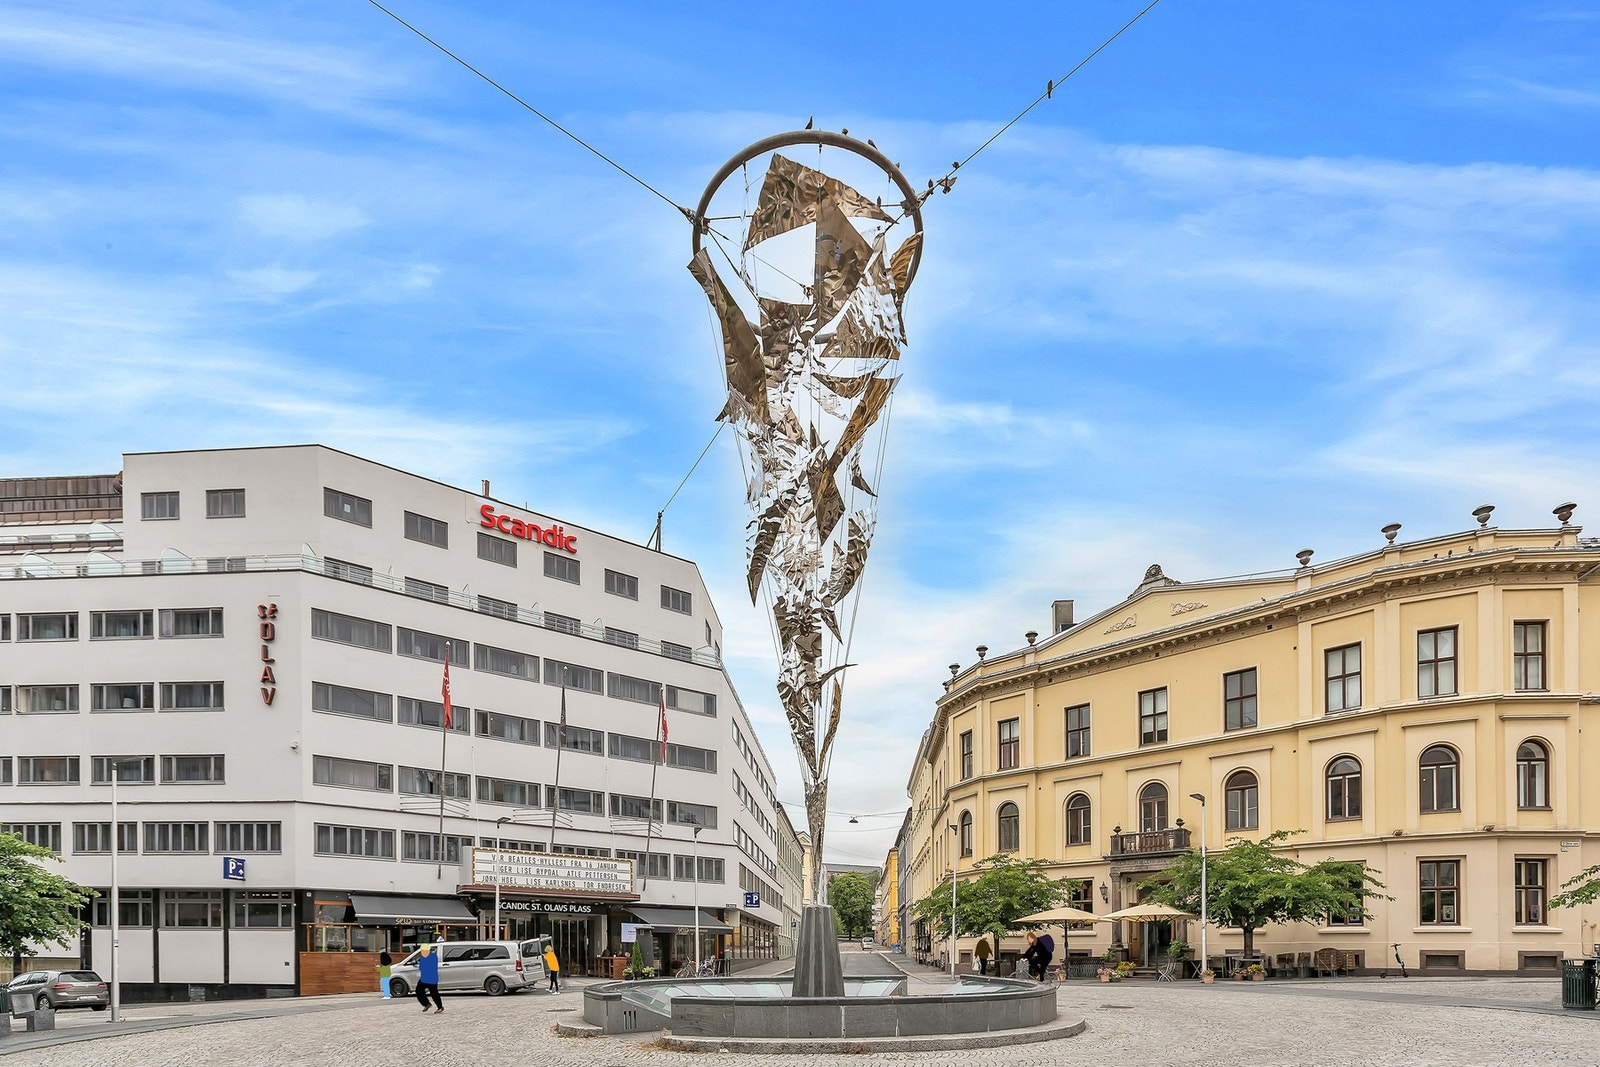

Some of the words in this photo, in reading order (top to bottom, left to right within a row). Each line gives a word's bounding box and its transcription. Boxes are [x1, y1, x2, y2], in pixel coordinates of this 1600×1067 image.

[480, 504, 578, 553] Scandic
[260, 622, 276, 706] OLAV
[229, 860, 236, 874] P
[586, 872, 618, 880] PETTERSEN
[752, 895, 758, 904] P
[544, 904, 568, 912] OLAVS
[569, 904, 592, 913] PLASS
